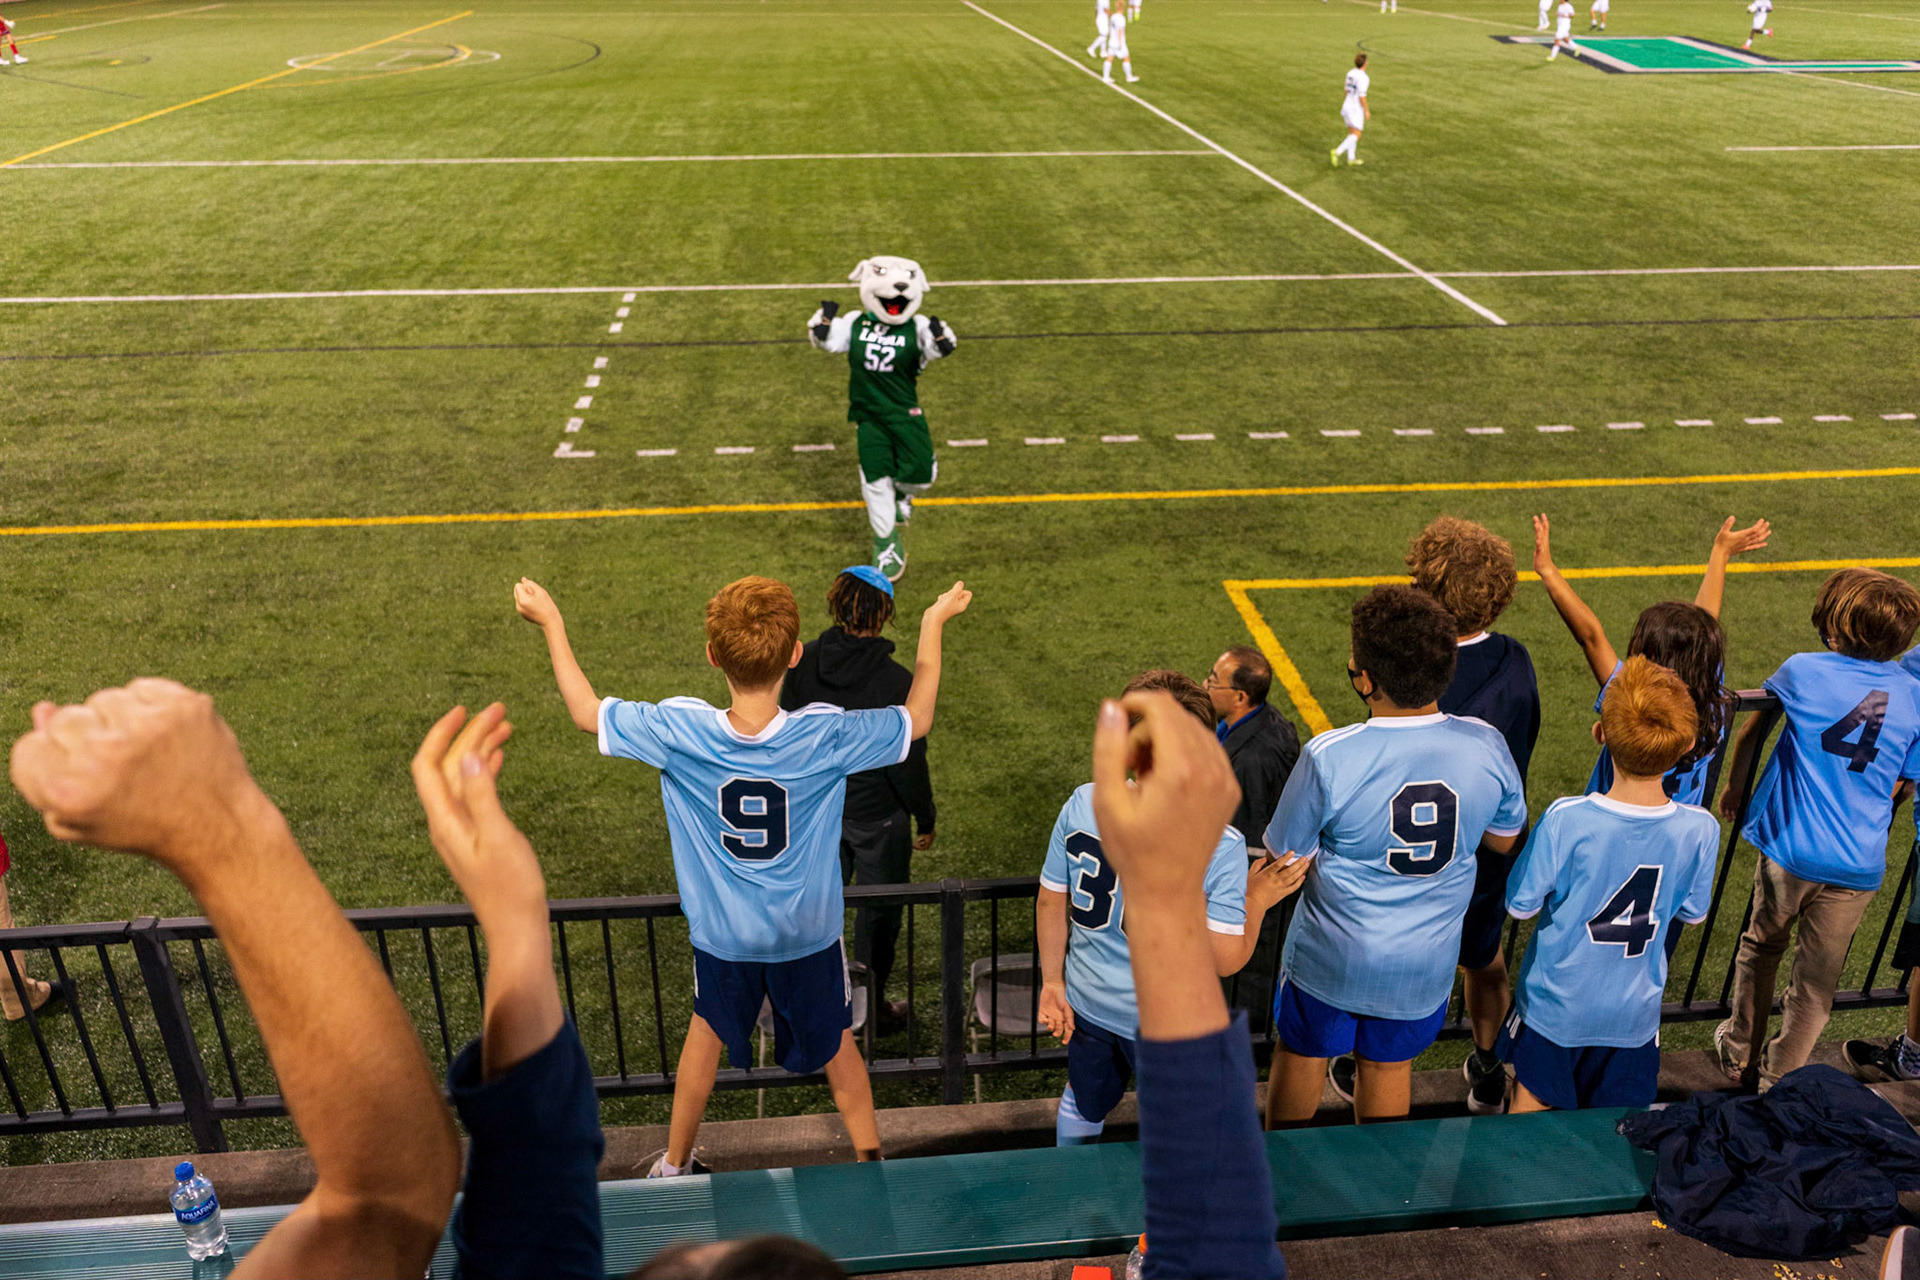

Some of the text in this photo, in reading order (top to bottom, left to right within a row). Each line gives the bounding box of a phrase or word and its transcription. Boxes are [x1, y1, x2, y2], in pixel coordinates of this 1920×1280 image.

[864, 343, 896, 372] 52
[1820, 689, 1890, 773] 4
[718, 776, 790, 862] 9
[1385, 779, 1460, 877] 9
[1586, 864, 1664, 958] 4
[181, 1200, 215, 1221] AQUAFINA
